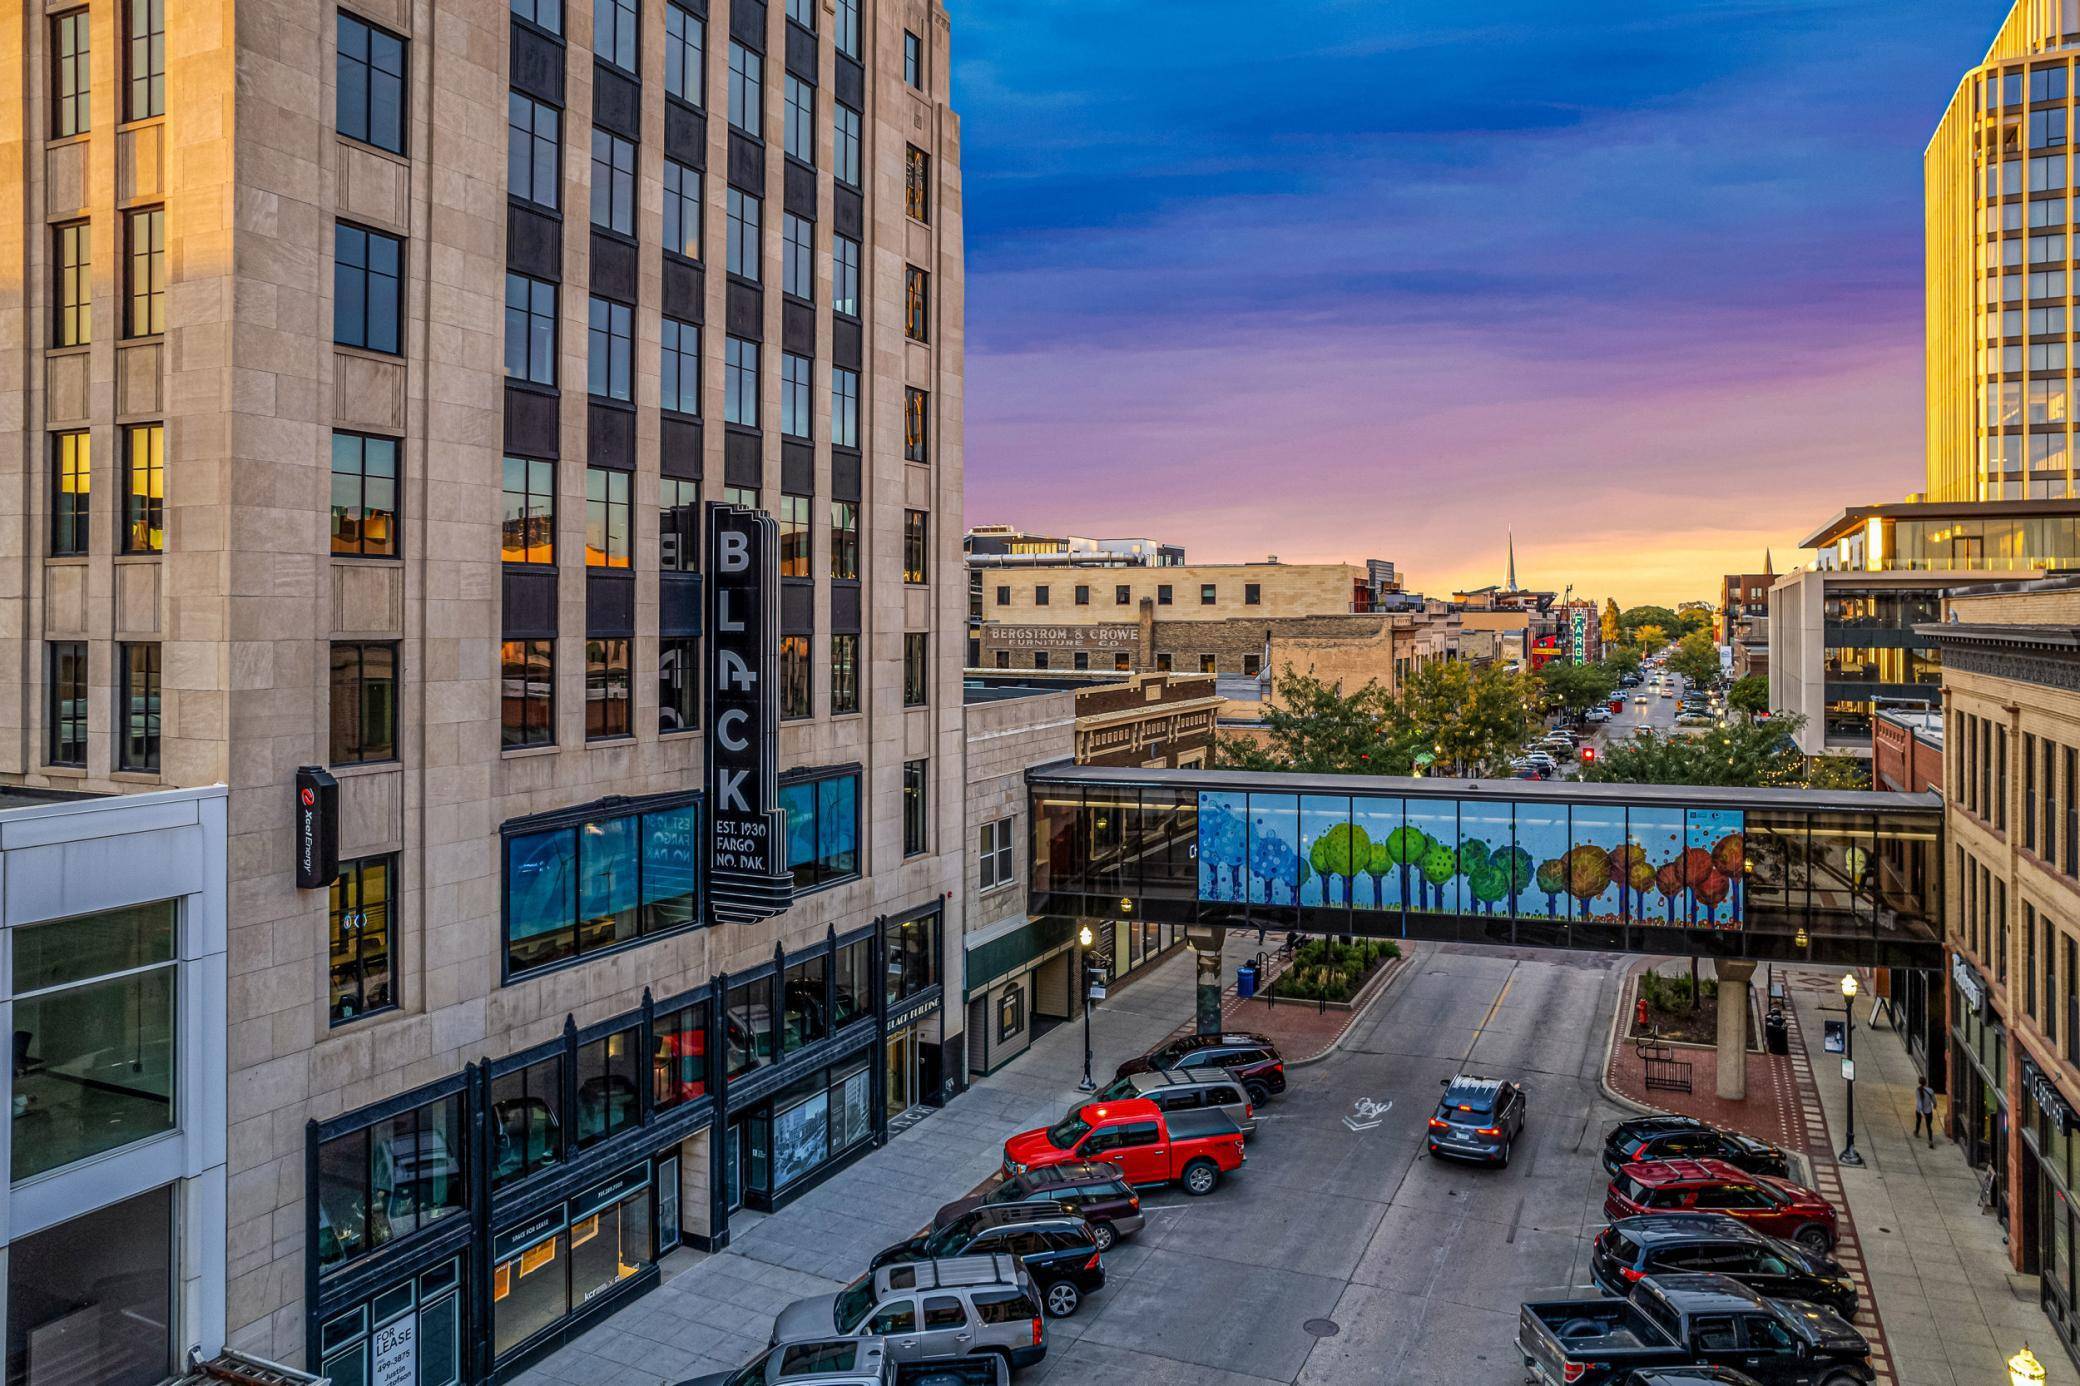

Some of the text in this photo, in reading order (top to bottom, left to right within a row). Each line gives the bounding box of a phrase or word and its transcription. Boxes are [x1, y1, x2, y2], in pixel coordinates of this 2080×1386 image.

[992, 628, 1139, 641] BERGSTROM & CROWE
[1575, 615, 1583, 667] FARGO
[718, 531, 757, 813] BLACK
[716, 820, 766, 837] EST. 1930
[717, 837, 755, 852] FARGO
[716, 853, 766, 870] NO. DAK.
[887, 997, 940, 1031] BLACK BUILDING
[376, 1327, 395, 1345] FOR
[376, 1328, 412, 1357] LEASE
